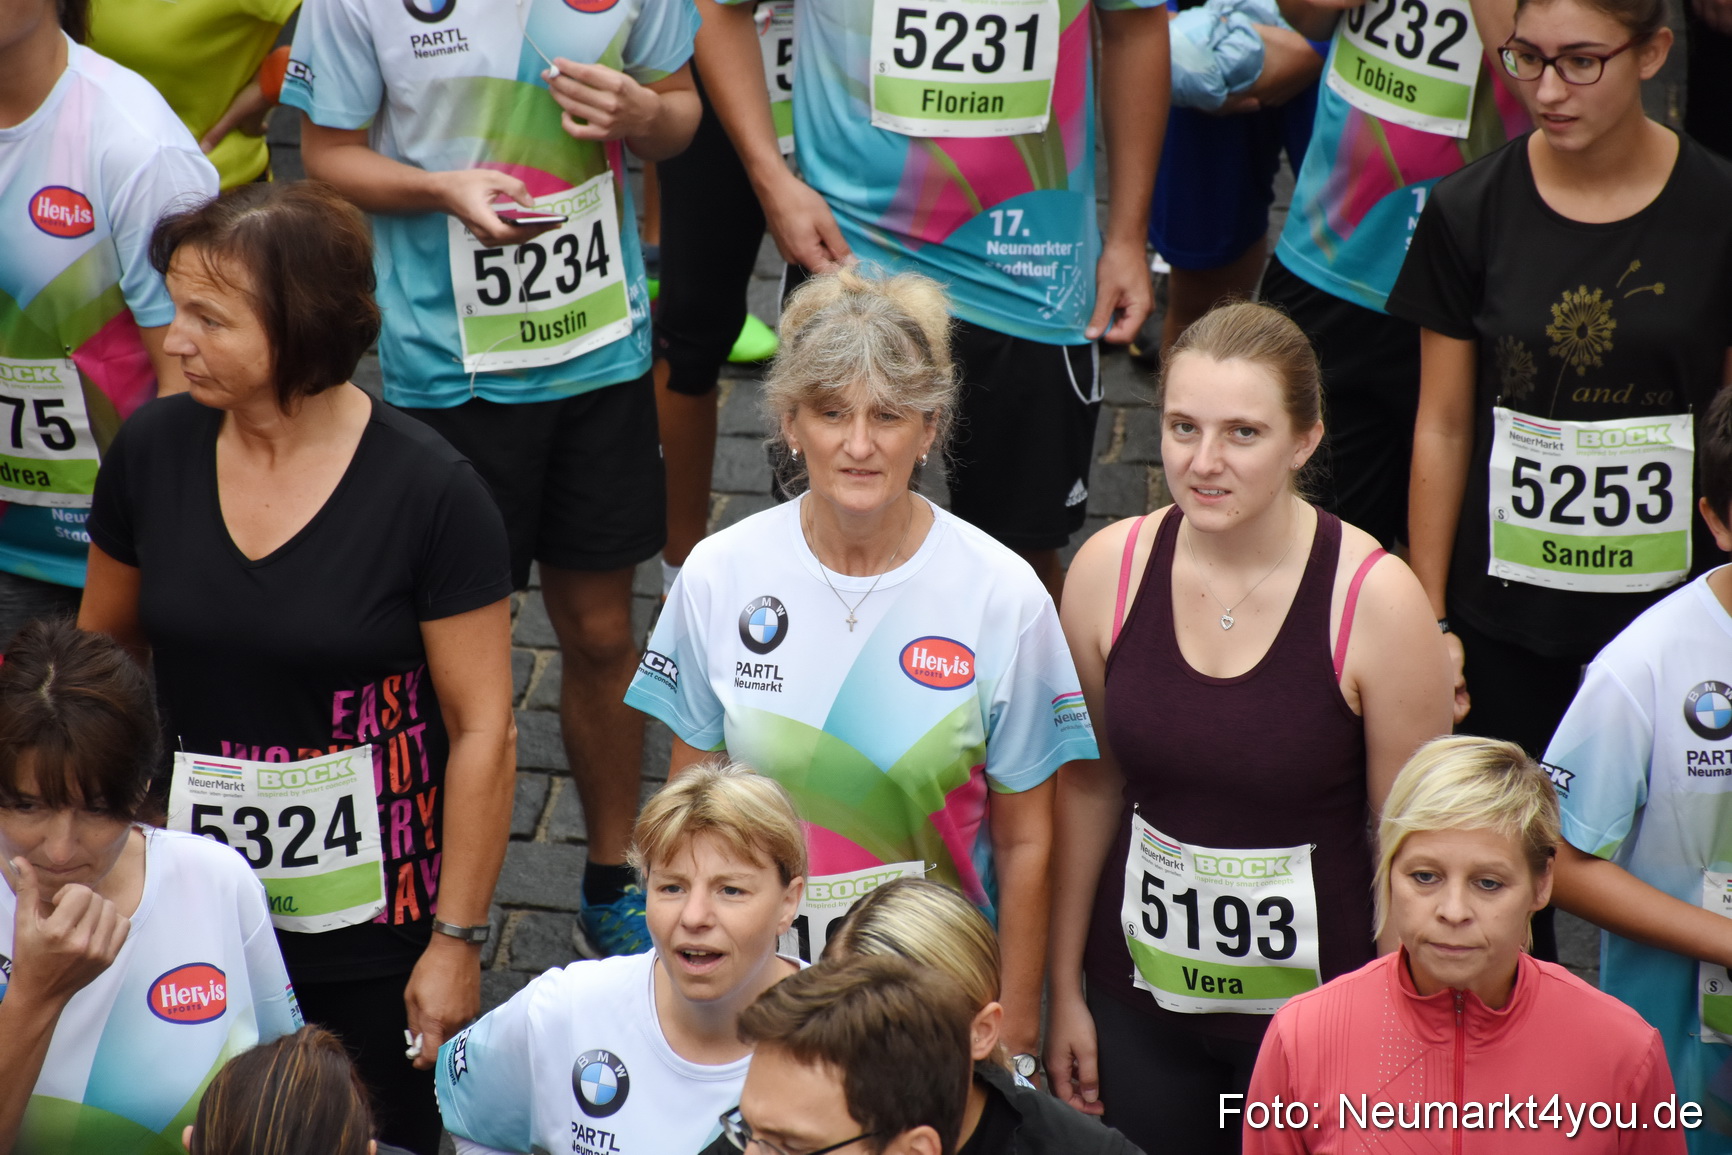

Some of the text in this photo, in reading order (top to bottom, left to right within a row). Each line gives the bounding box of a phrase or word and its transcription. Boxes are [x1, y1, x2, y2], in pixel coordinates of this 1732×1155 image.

[410, 28, 467, 49] PARTL
[414, 42, 470, 59] Neumarkt
[893, 8, 1039, 73] 5231
[879, 62, 886, 73] S
[1356, 56, 1417, 103] Tobias
[922, 89, 1004, 113] Florian
[37, 196, 92, 226] Hervis
[532, 183, 601, 217] OCK
[989, 209, 1030, 237] 17.
[987, 240, 1072, 256] Neumarkter
[474, 219, 610, 307] 5234
[985, 261, 1059, 280] adtlauf
[465, 305, 473, 315] S
[520, 310, 587, 343] Dustin
[1572, 383, 1635, 404] and
[0, 394, 76, 451] 75
[1509, 430, 1564, 451] NeuerMarkt
[1576, 423, 1674, 449] BOCK
[1511, 456, 1673, 527] 5253
[1498, 509, 1505, 520] S
[1542, 540, 1633, 568] Sandra
[745, 597, 786, 617] BMW
[642, 650, 679, 688] CK
[736, 661, 784, 681] PARTL
[912, 647, 970, 677] Hervis
[915, 669, 942, 678] SPORTS
[734, 677, 783, 693] Neumarkt
[332, 664, 426, 743] EASY
[188, 755, 356, 792] NeuerMarkt BOCK
[257, 790, 289, 798] inspired
[291, 789, 300, 797] by
[301, 785, 324, 794] smart
[191, 794, 362, 869] 5324
[1140, 841, 1184, 872] NeuerMarkt
[1193, 853, 1293, 879] BOCK
[1195, 873, 1294, 887] inspired by smart concepts
[805, 900, 848, 909] inspired by
[1141, 870, 1297, 960] 5193
[1128, 924, 1135, 935] S
[160, 980, 225, 1008] Hervis
[1182, 966, 1243, 994] Vera
[1710, 981, 1717, 992] S
[168, 1004, 201, 1015] SPORTS
[577, 1051, 627, 1079] BMW
[571, 1121, 621, 1152] PARTL
